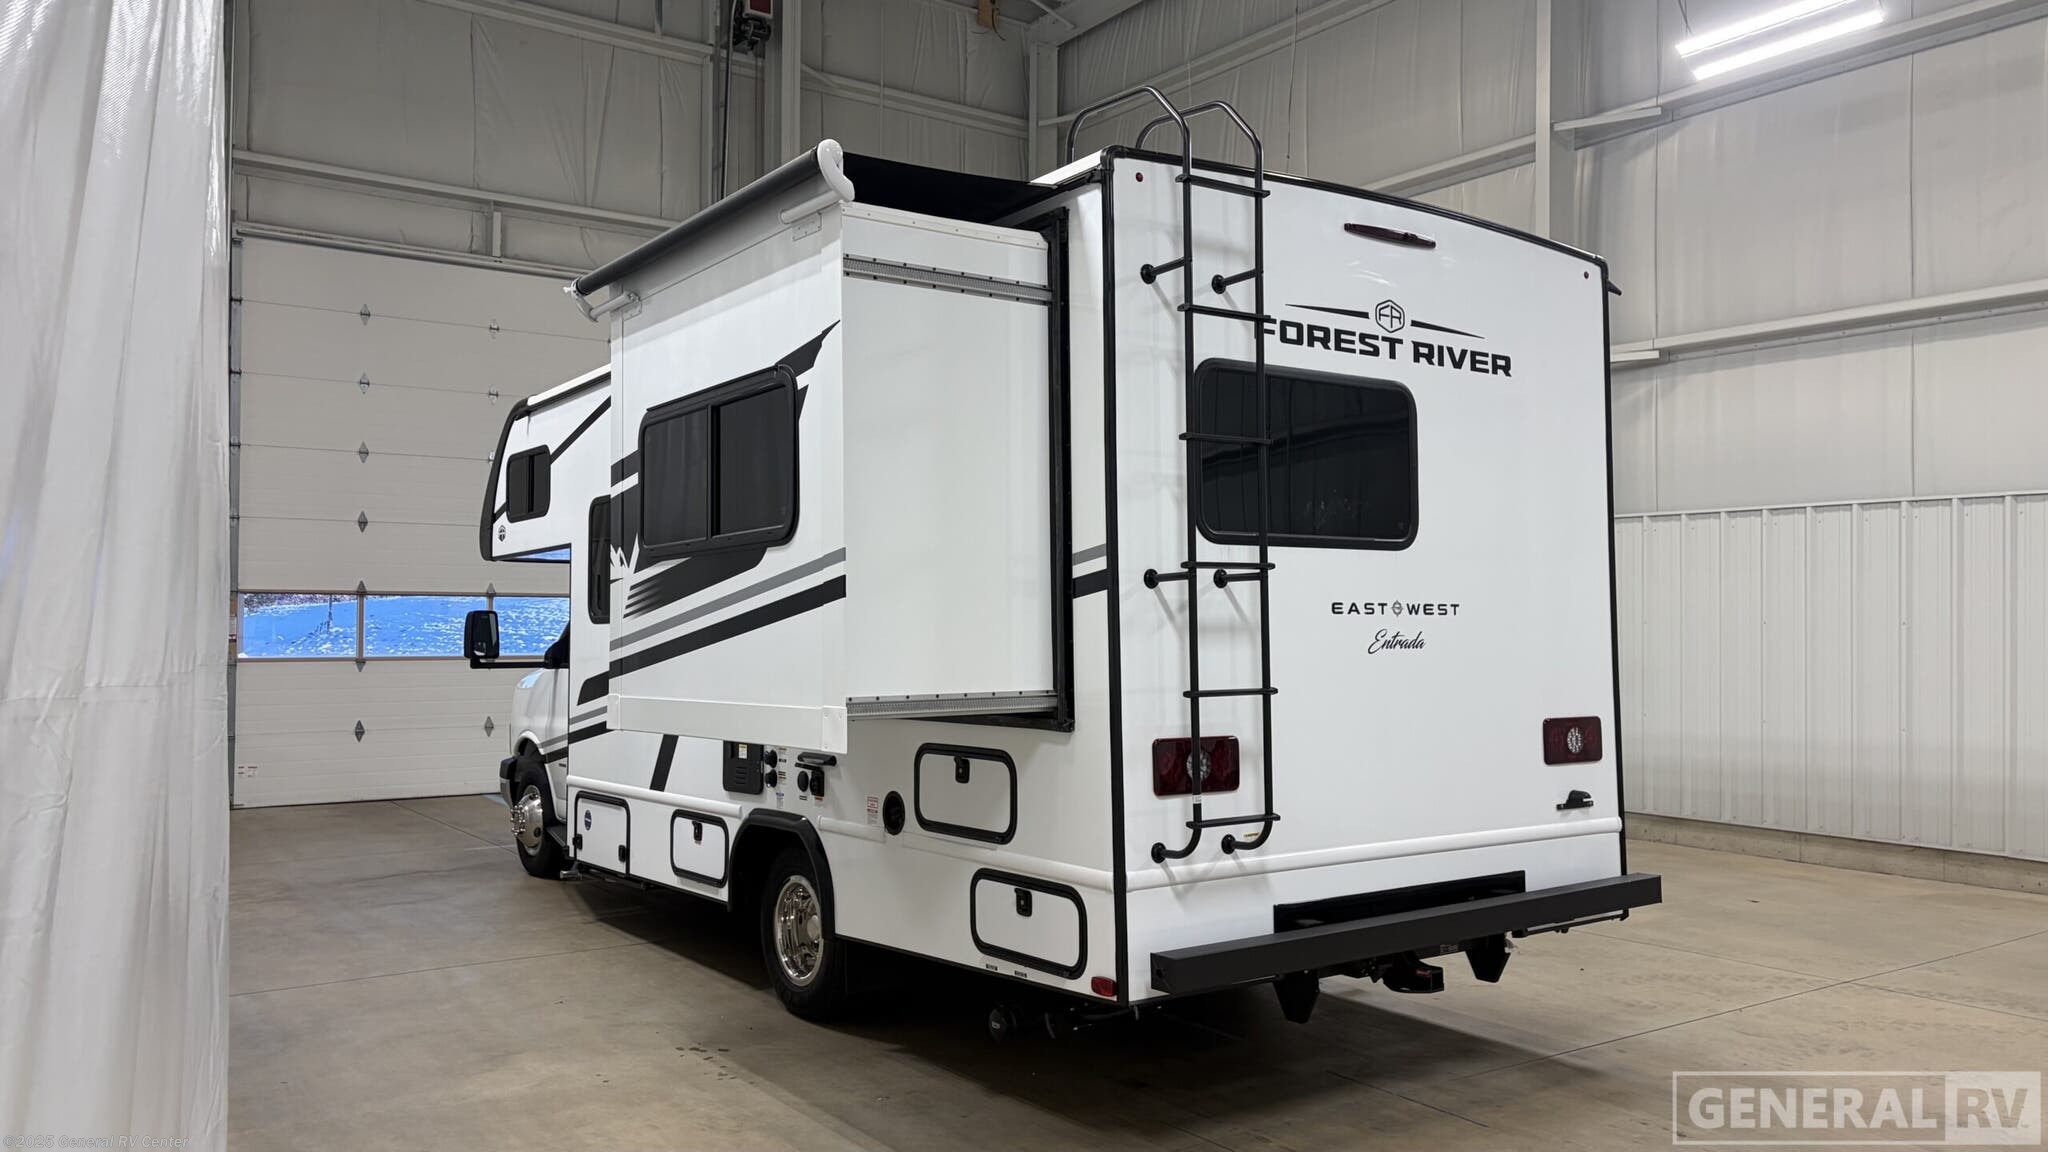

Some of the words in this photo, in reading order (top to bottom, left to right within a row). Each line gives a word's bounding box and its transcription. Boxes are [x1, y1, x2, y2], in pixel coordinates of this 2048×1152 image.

[1254, 315, 1403, 360] FOREST
[1411, 339, 1512, 377] RIVER
[1331, 601, 1388, 616] EAST
[1406, 602, 1460, 616] WEST
[1367, 628, 1427, 655] Entrada
